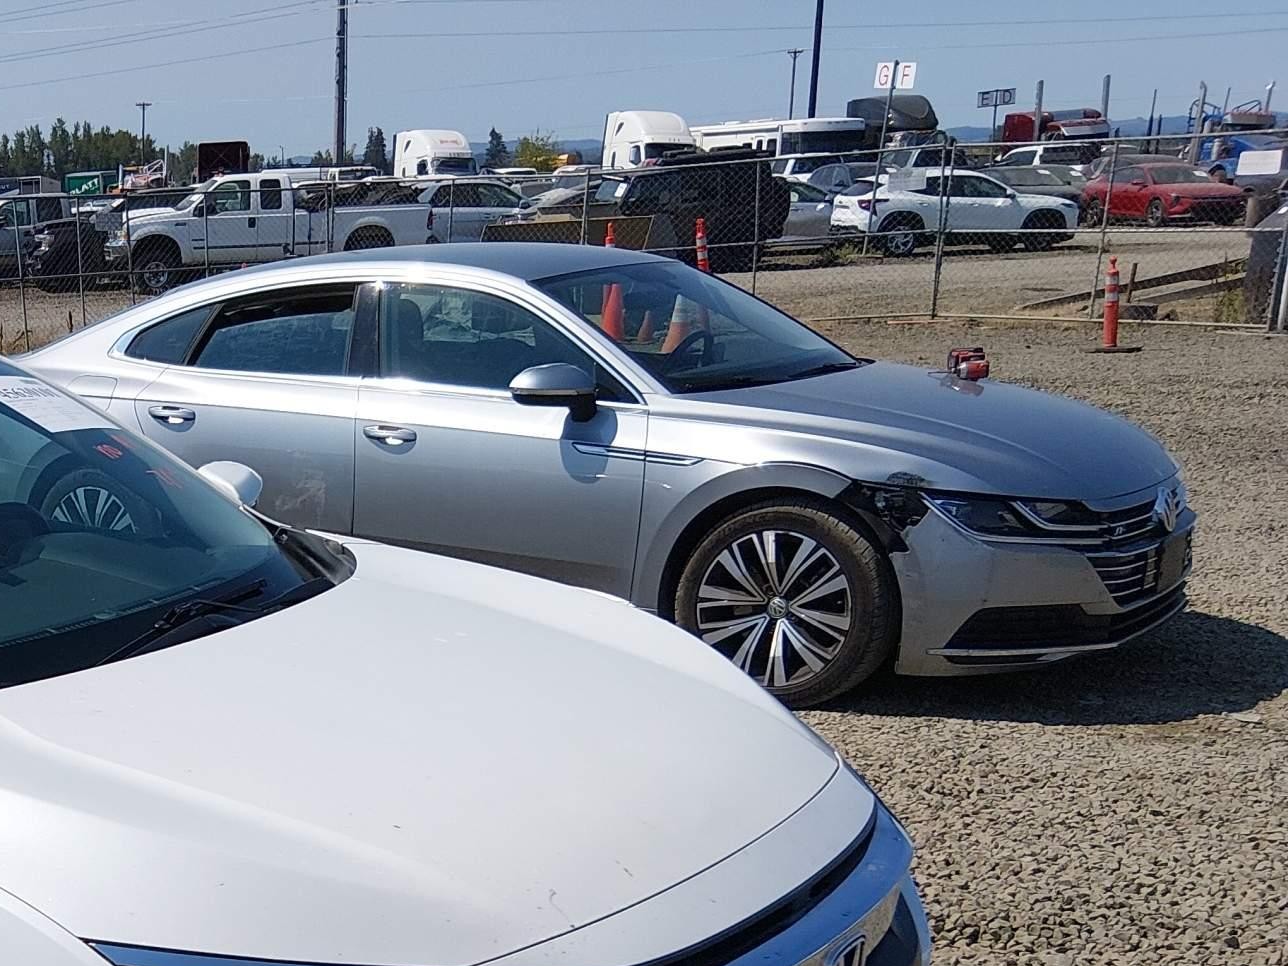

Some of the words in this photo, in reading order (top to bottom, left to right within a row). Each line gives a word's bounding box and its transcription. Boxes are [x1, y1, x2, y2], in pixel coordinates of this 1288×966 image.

[878, 64, 890, 86] G
[901, 65, 912, 86] F
[981, 91, 991, 106] E
[1002, 89, 1013, 104] D
